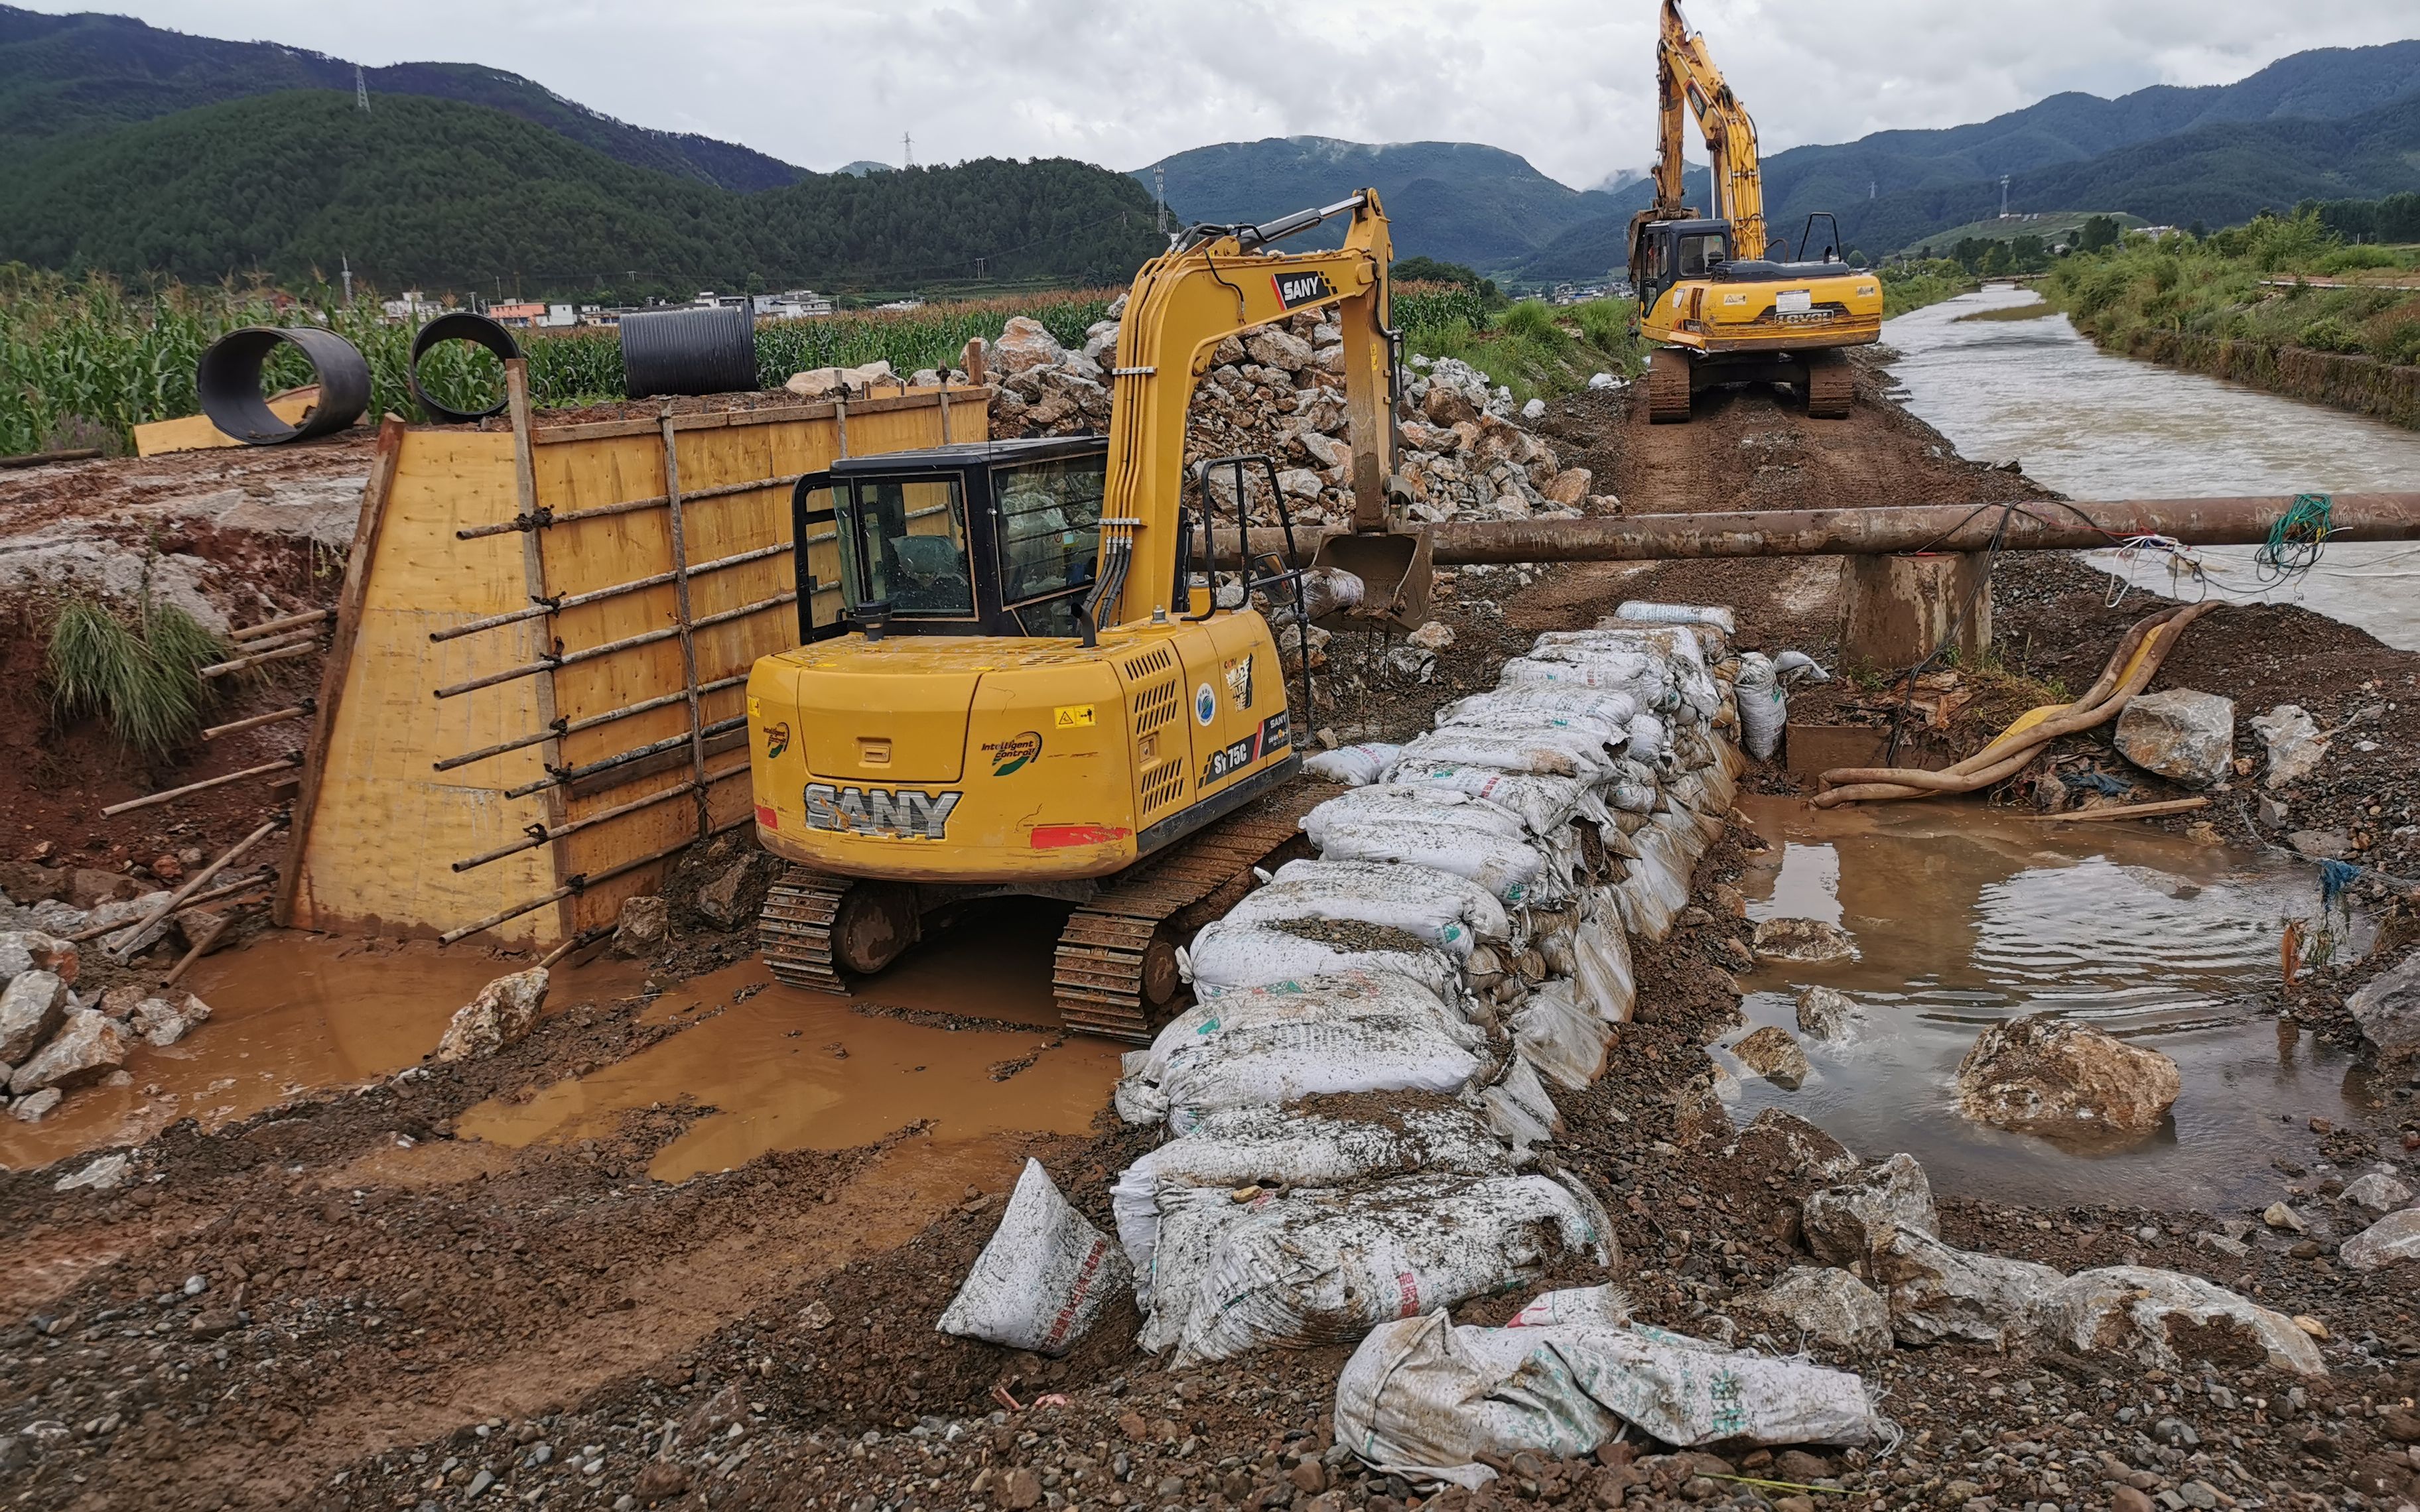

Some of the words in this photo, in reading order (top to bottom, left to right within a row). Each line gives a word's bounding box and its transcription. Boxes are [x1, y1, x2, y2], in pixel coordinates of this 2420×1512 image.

[1283, 276, 1318, 301] SANY
[1269, 712, 1286, 729] SANY
[981, 739, 1034, 751] Intelligent
[805, 783, 963, 840] SANY
